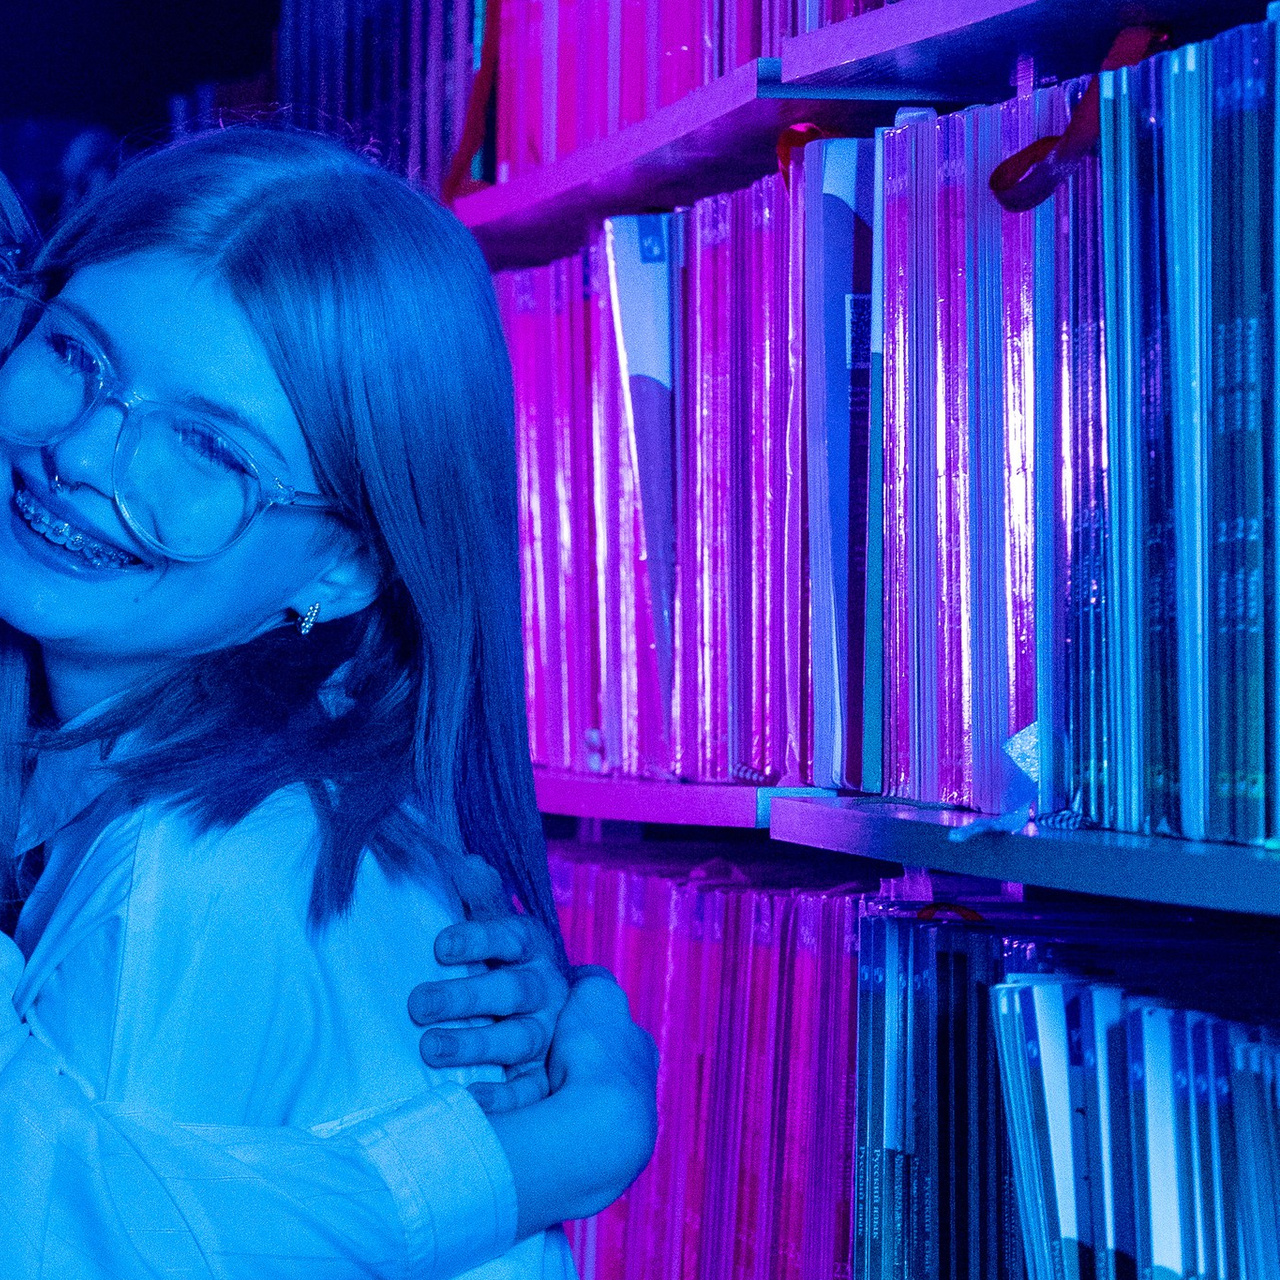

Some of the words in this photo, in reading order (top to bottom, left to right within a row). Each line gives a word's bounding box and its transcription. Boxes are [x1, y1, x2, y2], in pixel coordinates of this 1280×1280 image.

[856, 1146, 866, 1199] Русский
[871, 1149, 881, 1202] Русский
[872, 1206, 880, 1239] язык
[923, 1176, 932, 1232] Русский
[924, 1240, 932, 1273] язык
